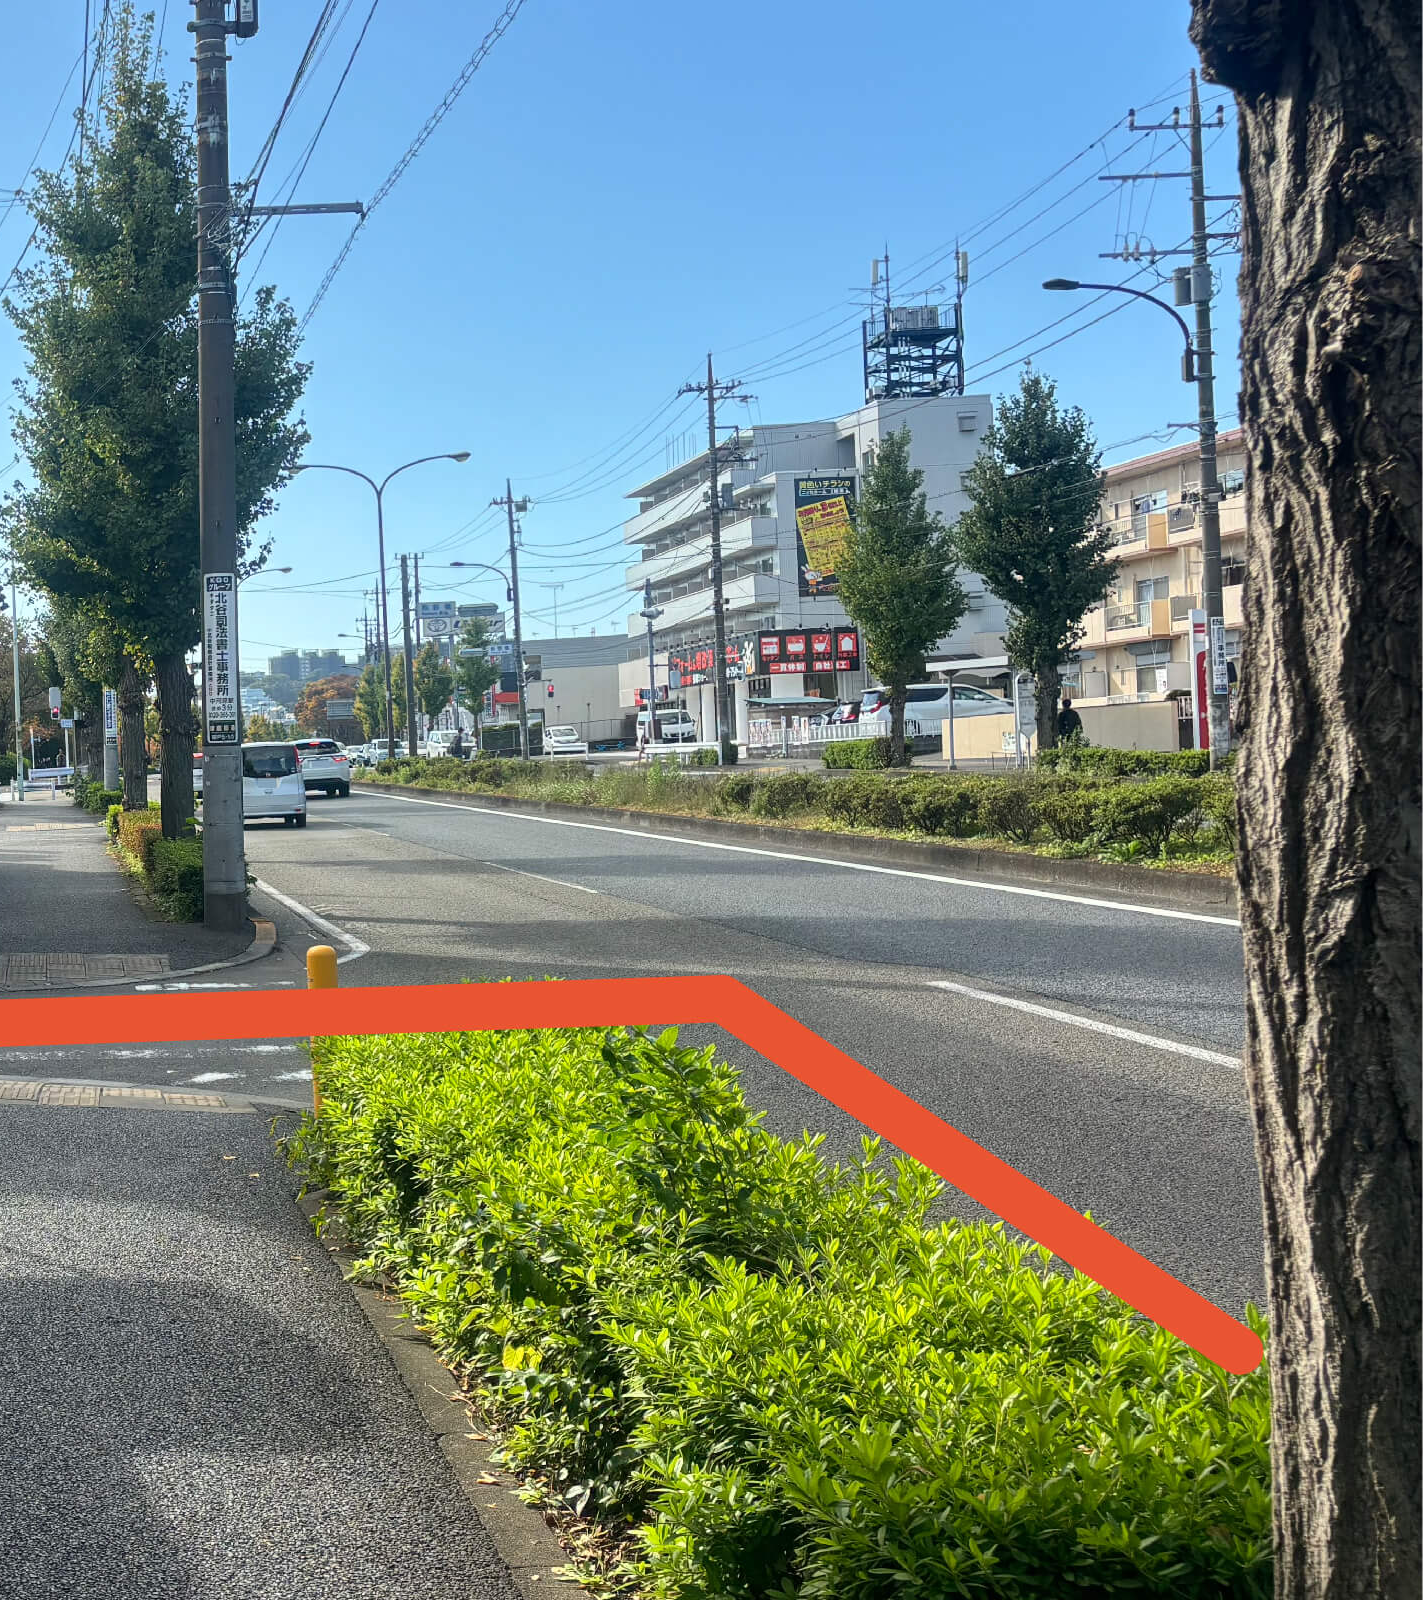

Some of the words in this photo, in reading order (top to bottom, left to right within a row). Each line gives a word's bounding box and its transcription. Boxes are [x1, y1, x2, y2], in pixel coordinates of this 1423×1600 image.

[208, 583, 231, 591] グループ
[215, 592, 229, 697] 北谷司法書士事務所
